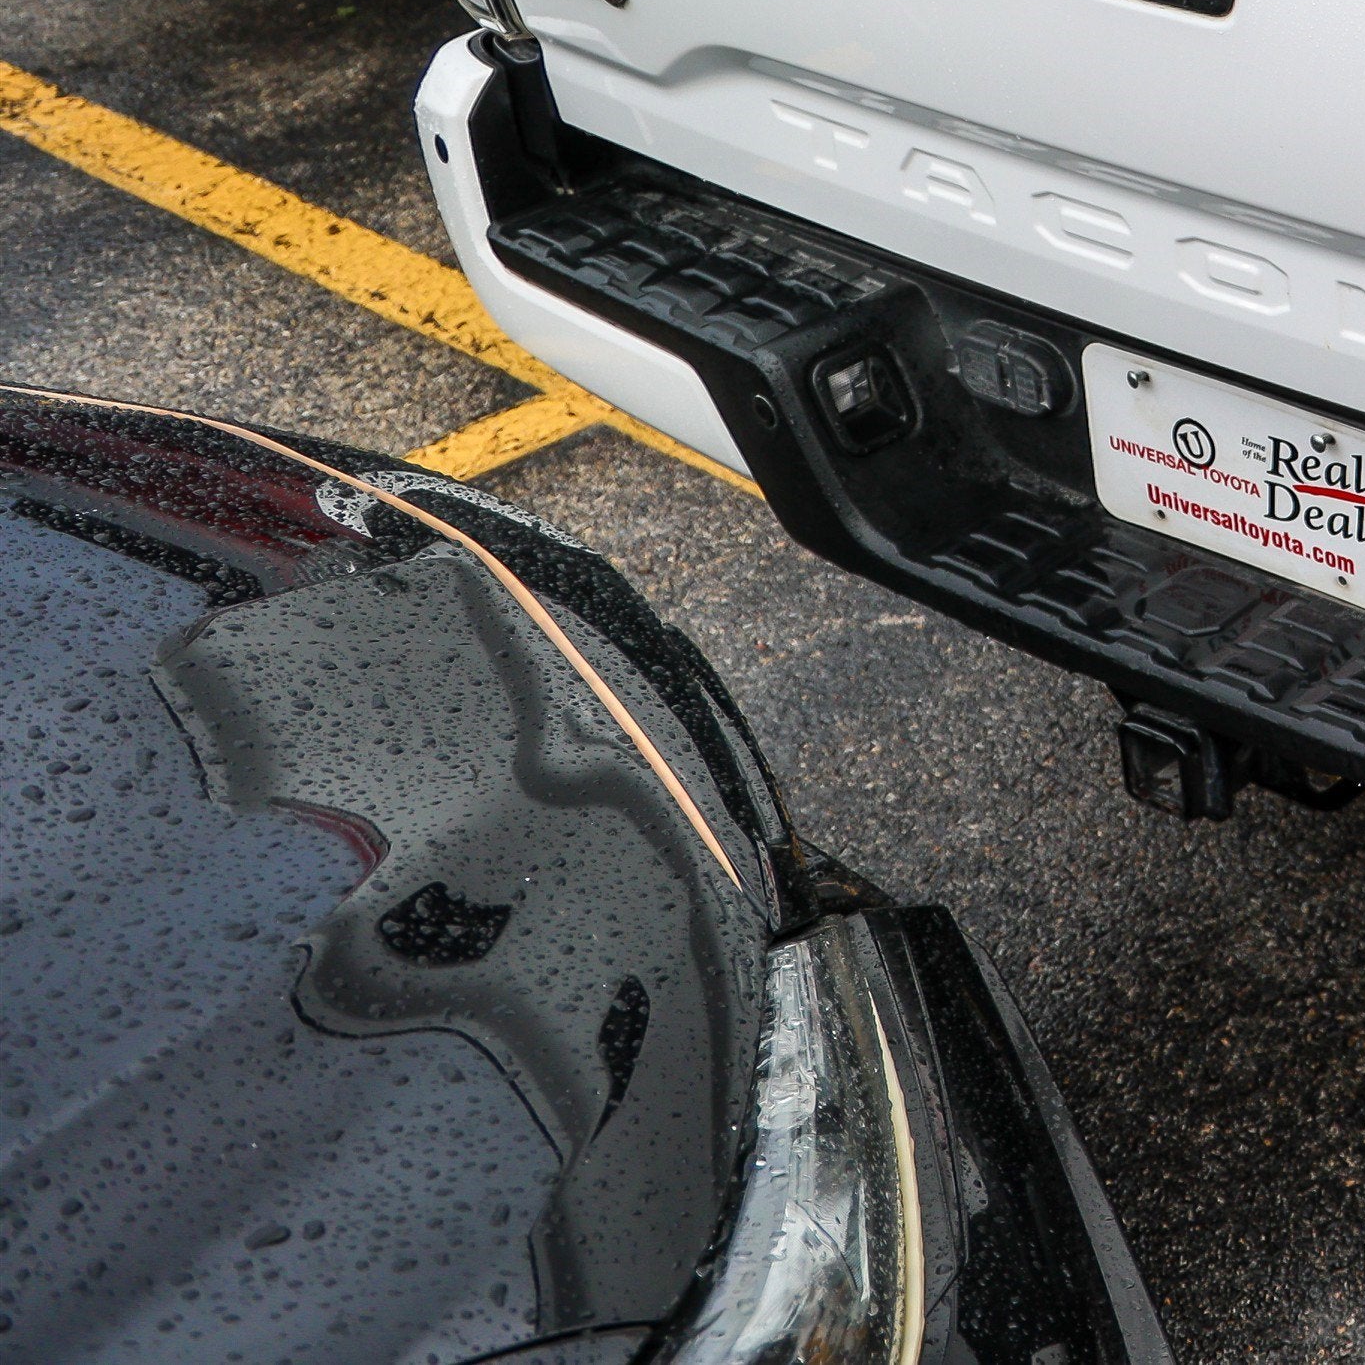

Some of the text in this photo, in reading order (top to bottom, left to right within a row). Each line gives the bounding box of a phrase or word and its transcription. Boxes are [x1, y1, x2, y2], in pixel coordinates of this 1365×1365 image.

[1109, 435, 1261, 499] UNIVERSAL TOYOTA
[1241, 436, 1266, 452] Home
[1242, 449, 1267, 464] of the
[1266, 435, 1365, 494] Real
[1147, 483, 1355, 576] Universaltoyota.com
